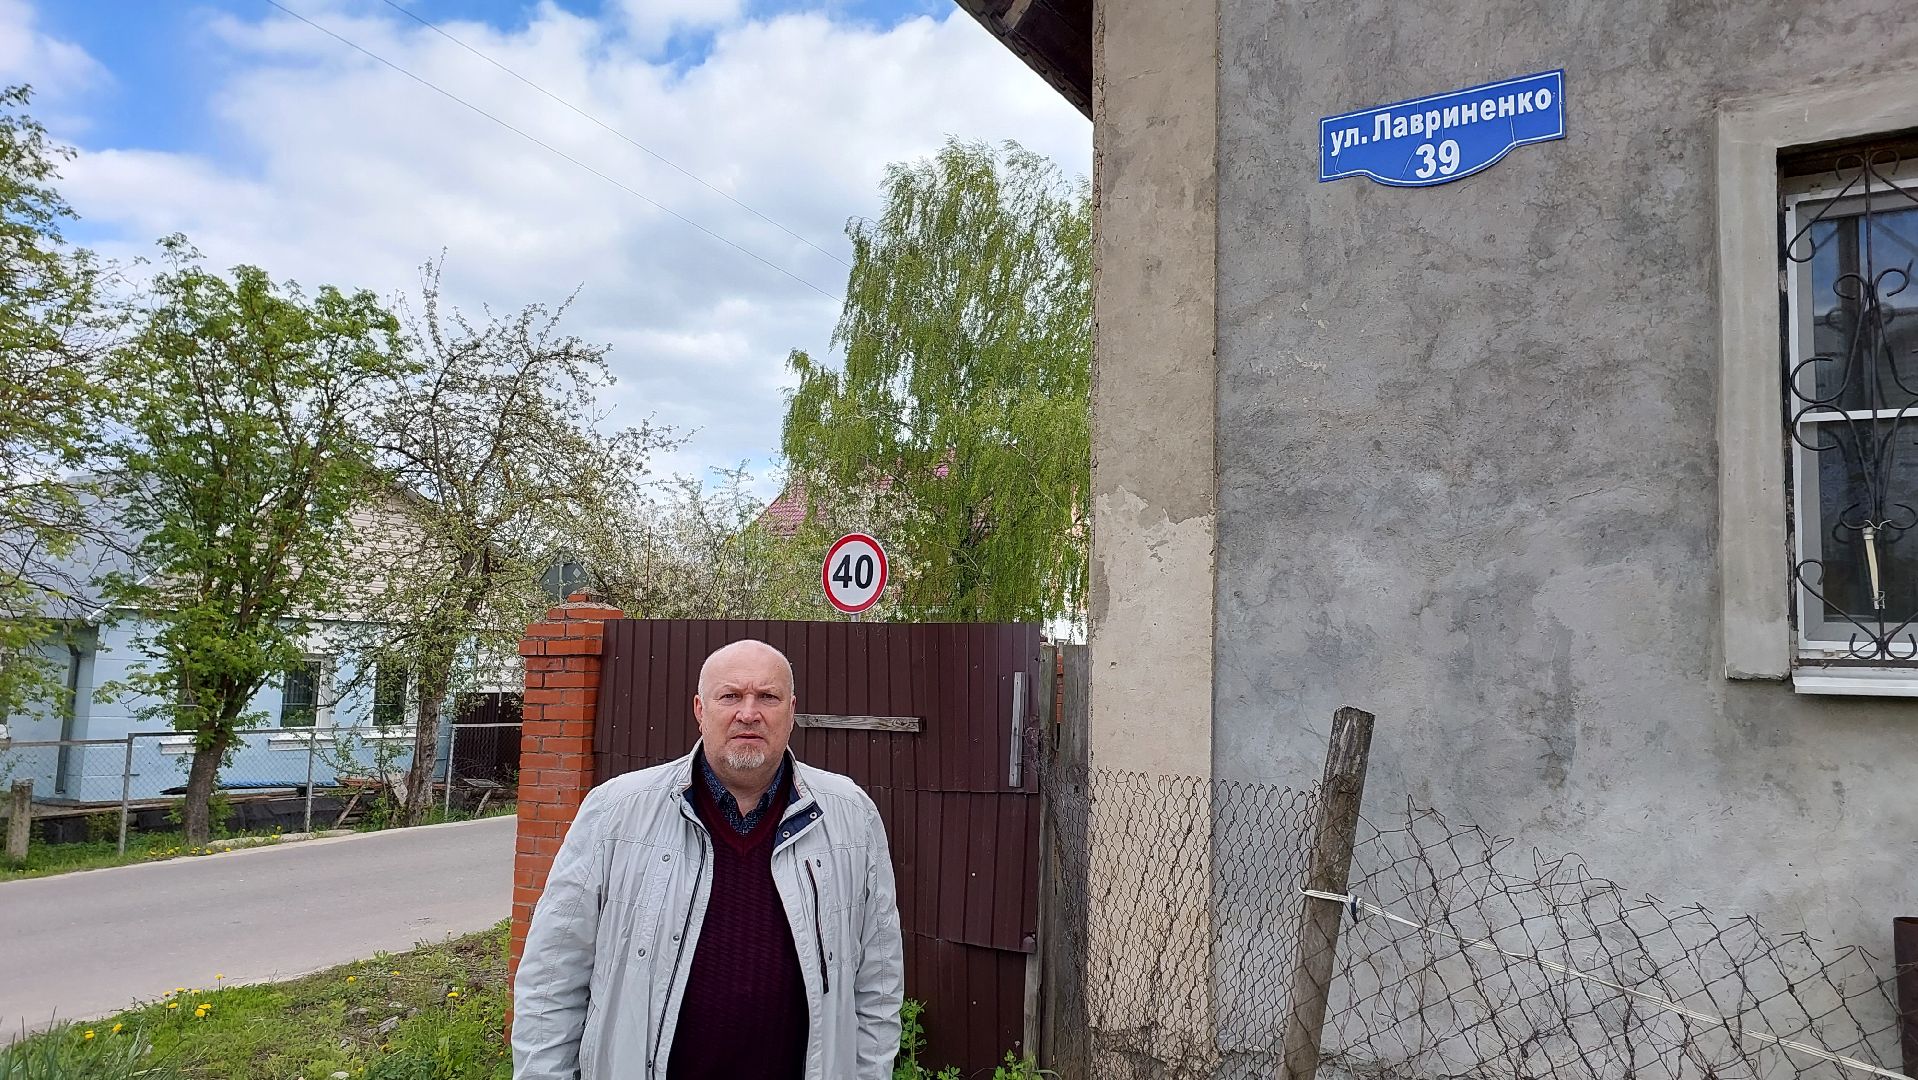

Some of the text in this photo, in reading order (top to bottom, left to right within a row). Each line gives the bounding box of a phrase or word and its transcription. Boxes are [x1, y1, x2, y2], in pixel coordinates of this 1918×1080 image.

[1331, 88, 1552, 156] ул. Лавриненко
[1415, 139, 1460, 179] 39
[832, 554, 874, 589] 40
